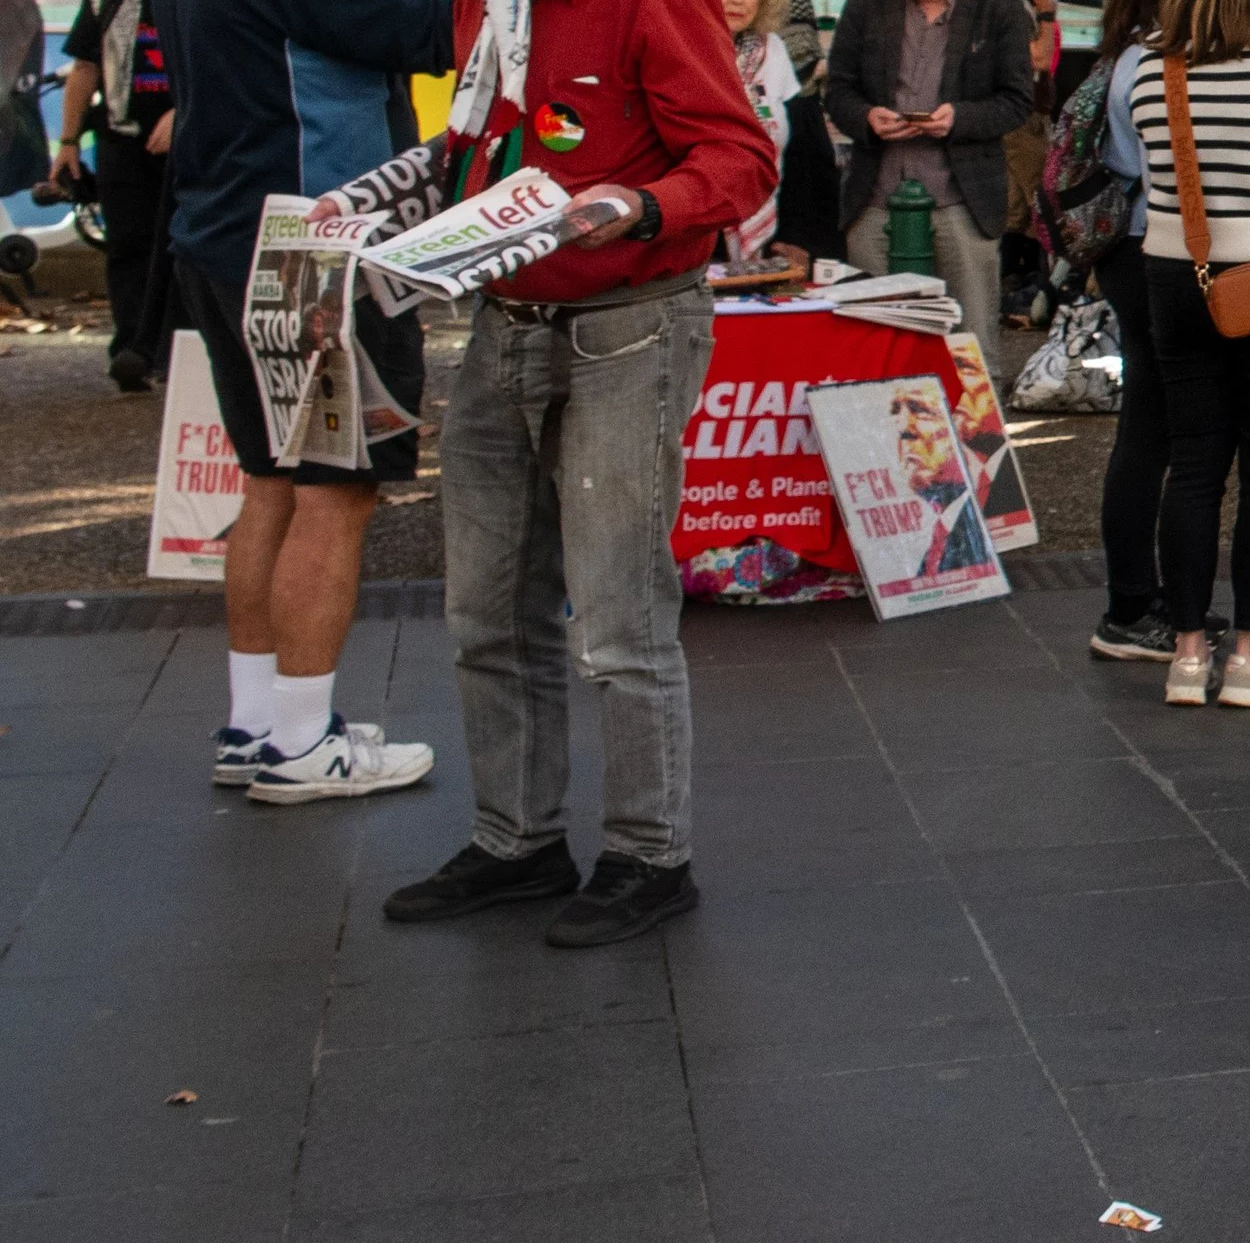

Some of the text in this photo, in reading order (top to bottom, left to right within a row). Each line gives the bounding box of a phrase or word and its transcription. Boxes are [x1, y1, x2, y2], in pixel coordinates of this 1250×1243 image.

[343, 147, 432, 213] STOP
[262, 214, 308, 245] green
[380, 222, 492, 266] green
[478, 184, 555, 230] left
[251, 309, 300, 353] STOP
[682, 418, 822, 460] LIAN
[745, 478, 764, 500] &
[771, 477, 832, 498] Plane
[682, 512, 757, 532] before
[856, 500, 923, 539] TRUMP
